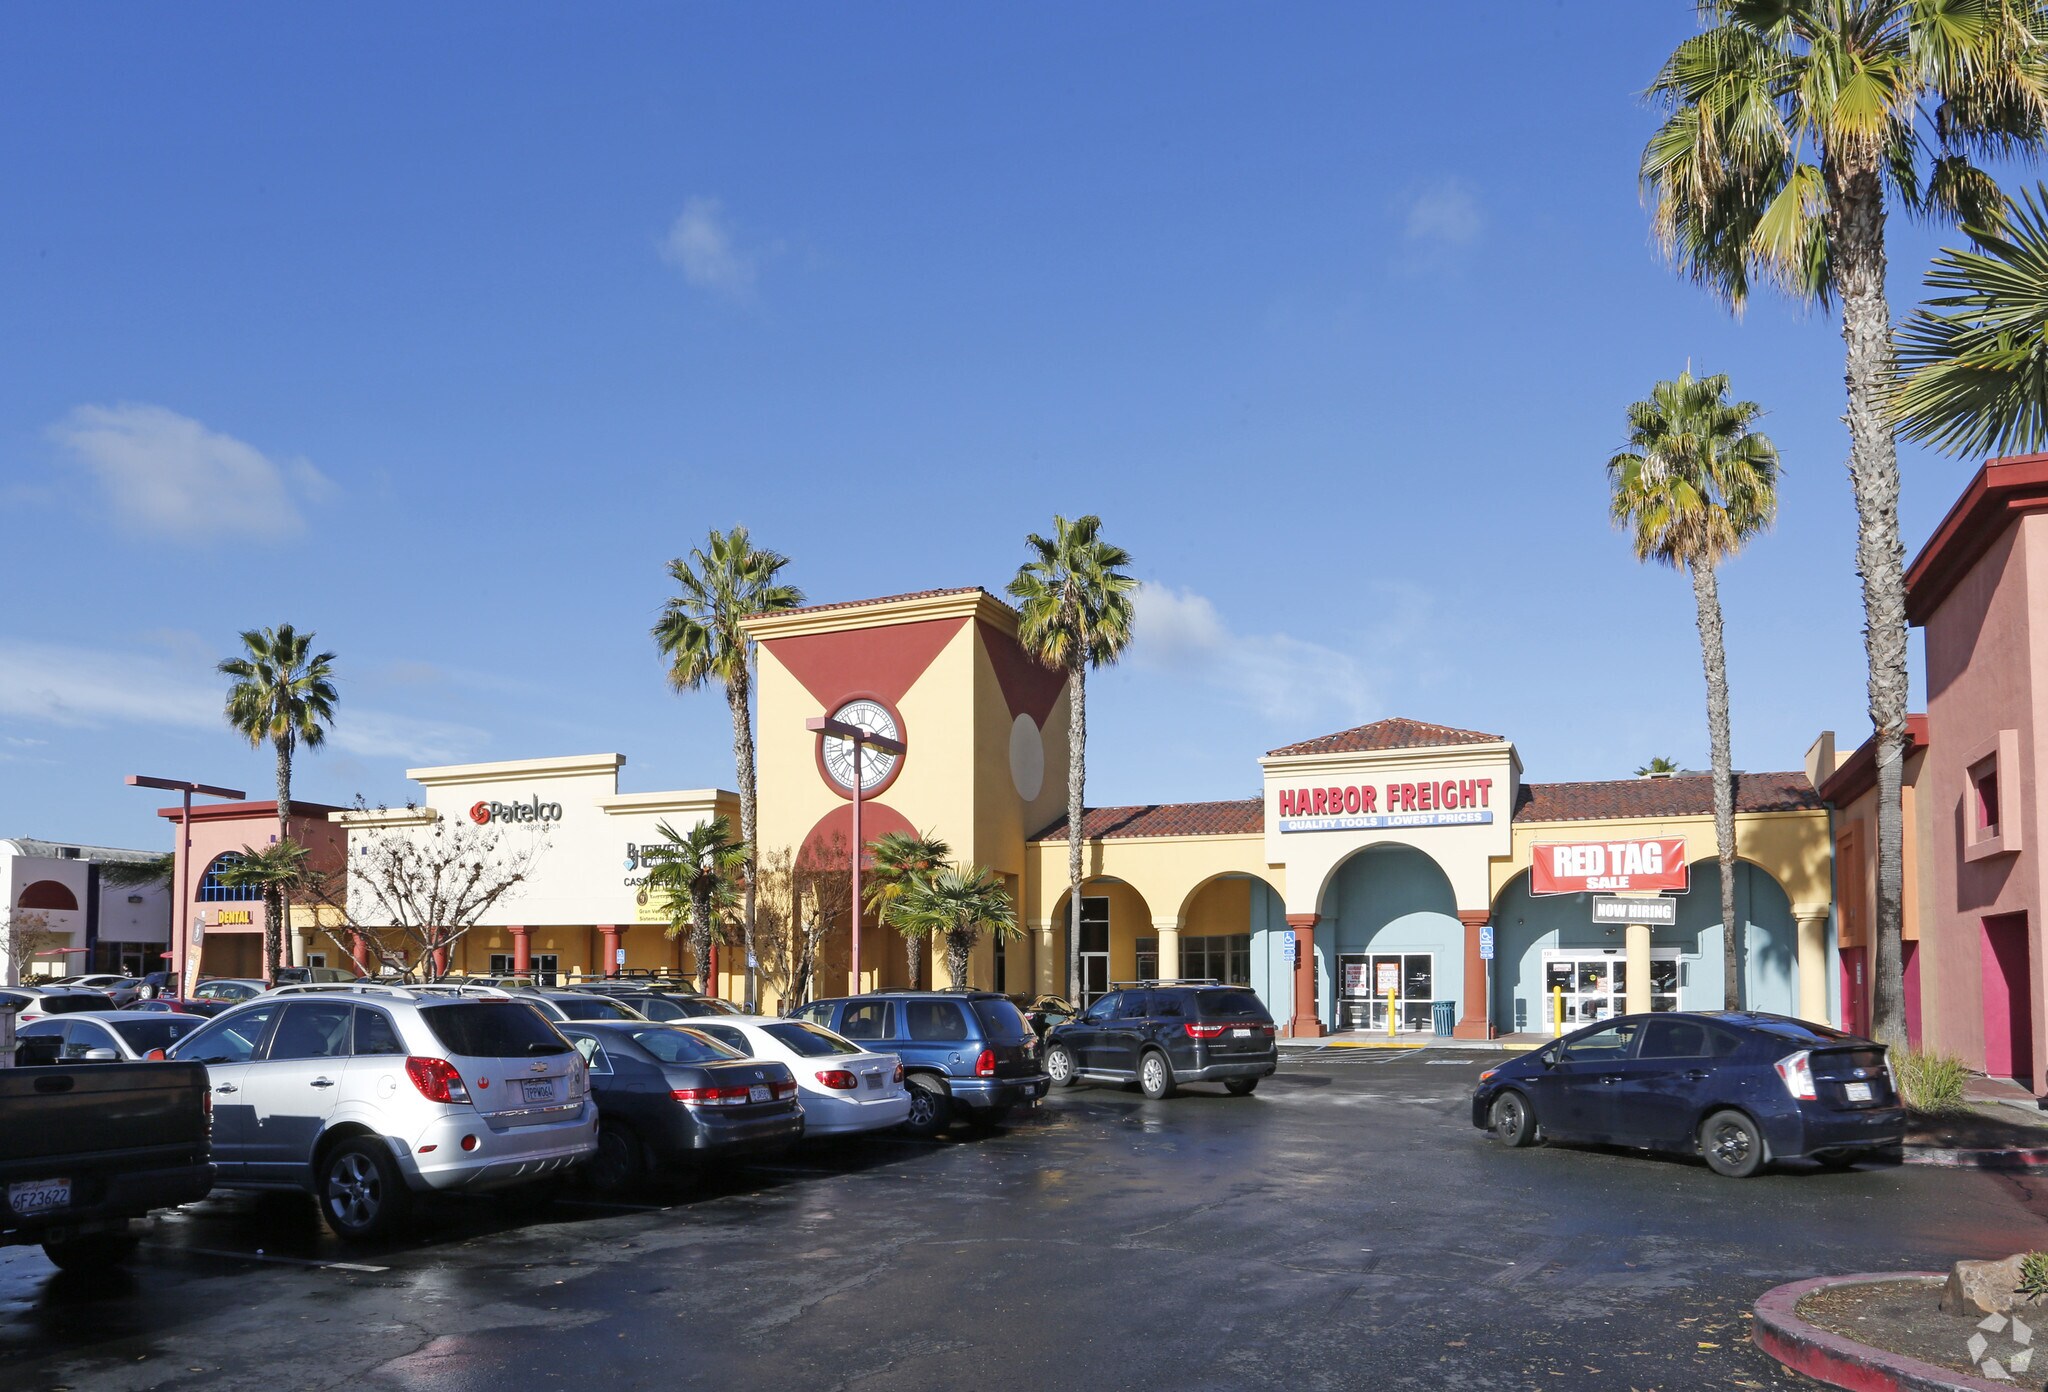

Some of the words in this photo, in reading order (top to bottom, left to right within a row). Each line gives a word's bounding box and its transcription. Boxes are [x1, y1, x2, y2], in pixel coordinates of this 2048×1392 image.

[1279, 785, 1377, 816] HARBOR
[1386, 778, 1493, 812] FREIGHT
[490, 792, 562, 824] Patelco
[1288, 819, 1338, 831] QUALITY
[1339, 817, 1378, 829] TOOLS
[1387, 815, 1434, 826] LOWEST
[1438, 812, 1483, 824] PRICES
[1553, 845, 1606, 877] RED
[1607, 841, 1663, 876] TAG
[1586, 876, 1629, 889] SALE
[218, 910, 250, 925] DENTAL
[1597, 904, 1627, 917] NOW
[1629, 904, 1672, 919] HIRING
[12, 1188, 68, 1211] 6F23622
